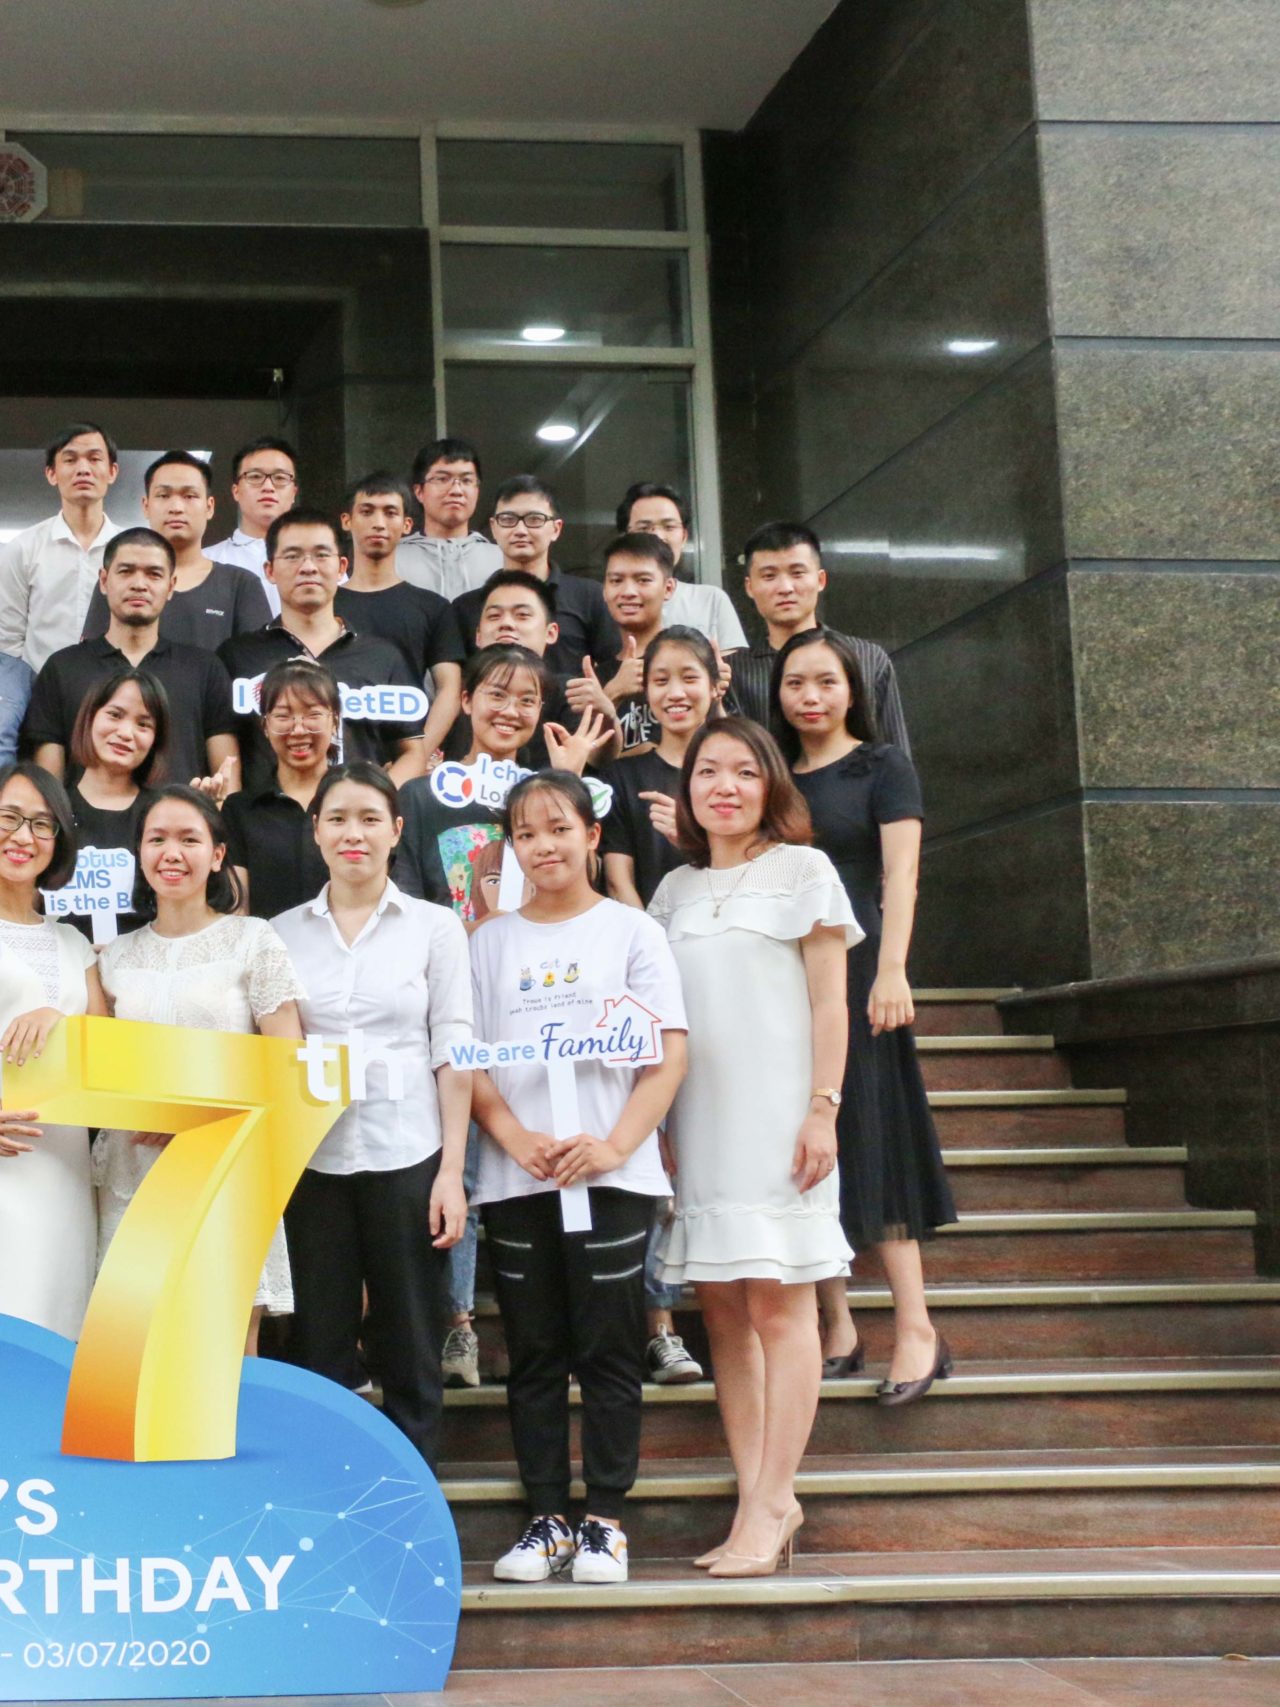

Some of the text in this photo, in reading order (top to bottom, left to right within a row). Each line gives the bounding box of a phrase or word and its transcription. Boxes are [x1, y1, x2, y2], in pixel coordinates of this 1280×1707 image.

[238, 684, 421, 716] I etED
[481, 757, 528, 783] I che
[76, 851, 129, 869] otus
[49, 894, 68, 912] is
[73, 893, 110, 910] the
[451, 1016, 648, 1065] We are Family
[23, 1639, 211, 1669] 03/07/2020
